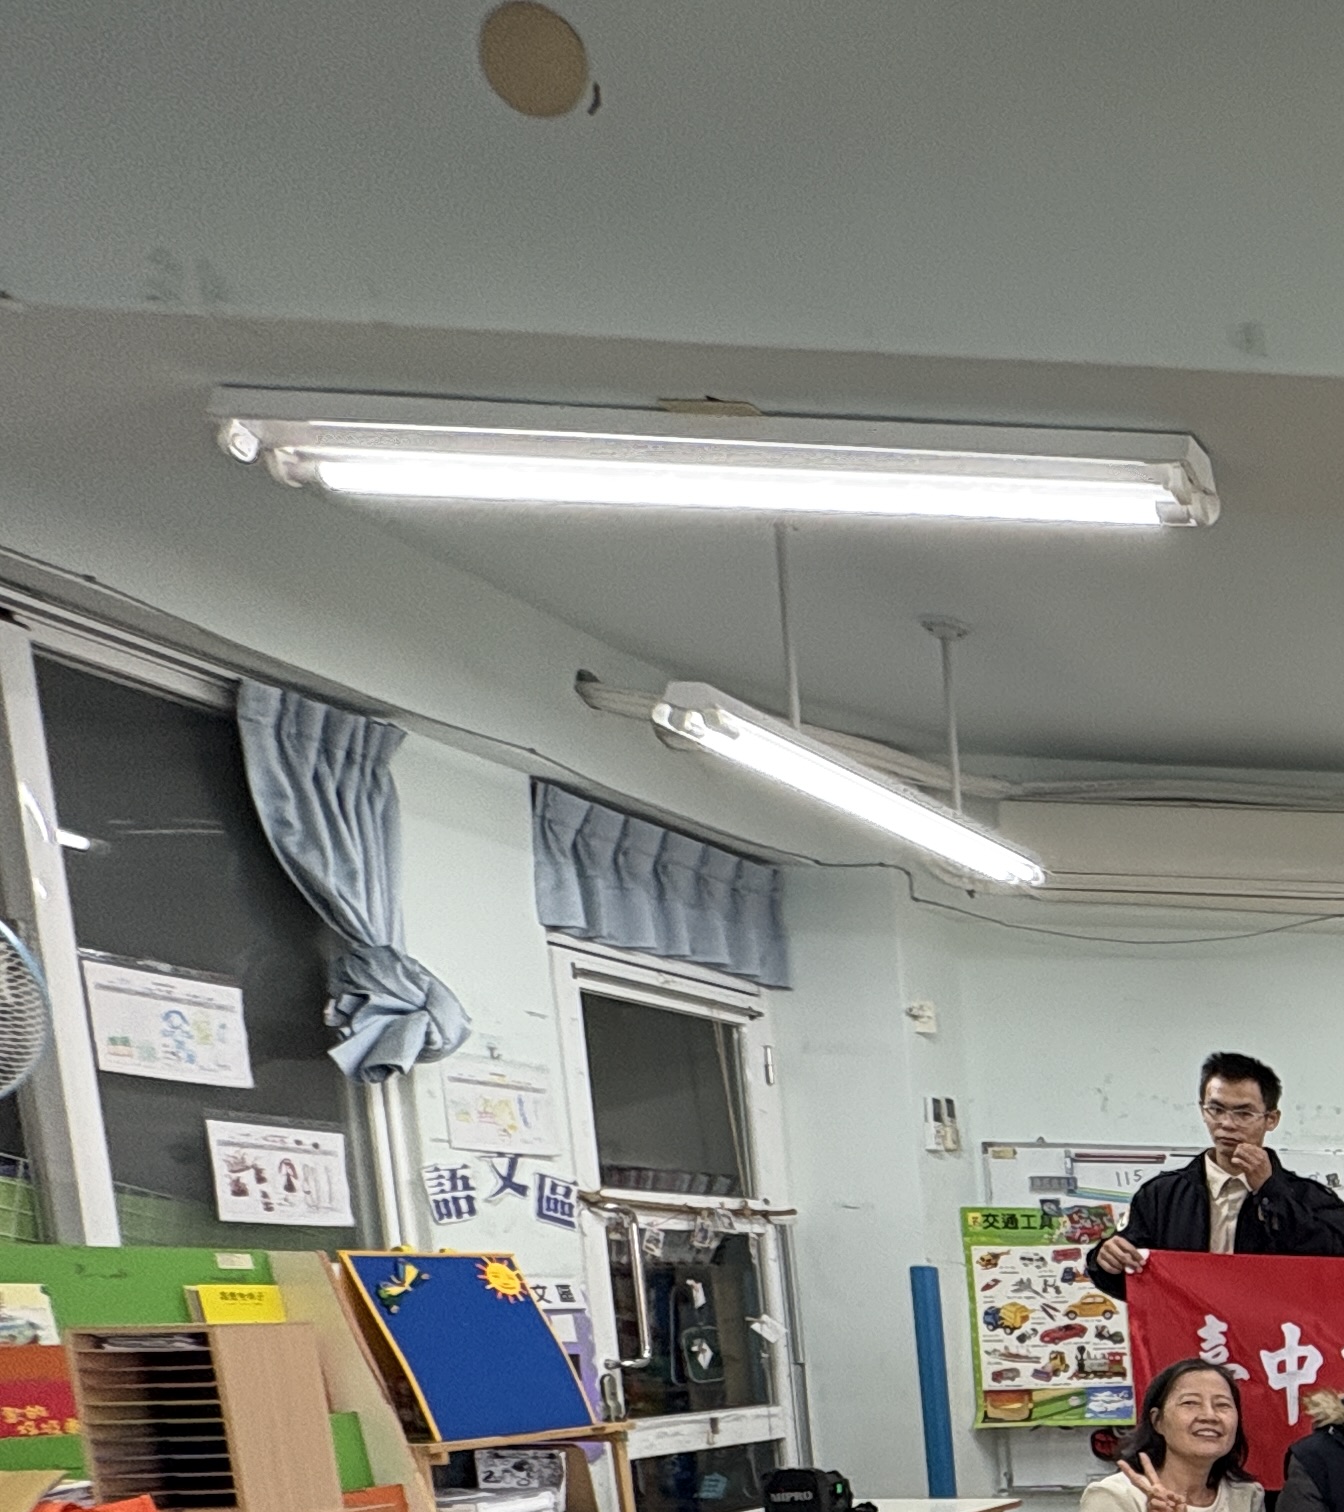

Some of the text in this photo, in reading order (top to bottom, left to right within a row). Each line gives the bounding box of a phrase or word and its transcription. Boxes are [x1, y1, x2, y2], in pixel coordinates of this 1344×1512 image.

[1115, 1169, 1144, 1187] 115
[424, 1153, 579, 1229] 語文區
[982, 1213, 1055, 1230] 交通工具
[530, 1284, 576, 1303] 文區
[770, 1490, 813, 1502] MIPRO
